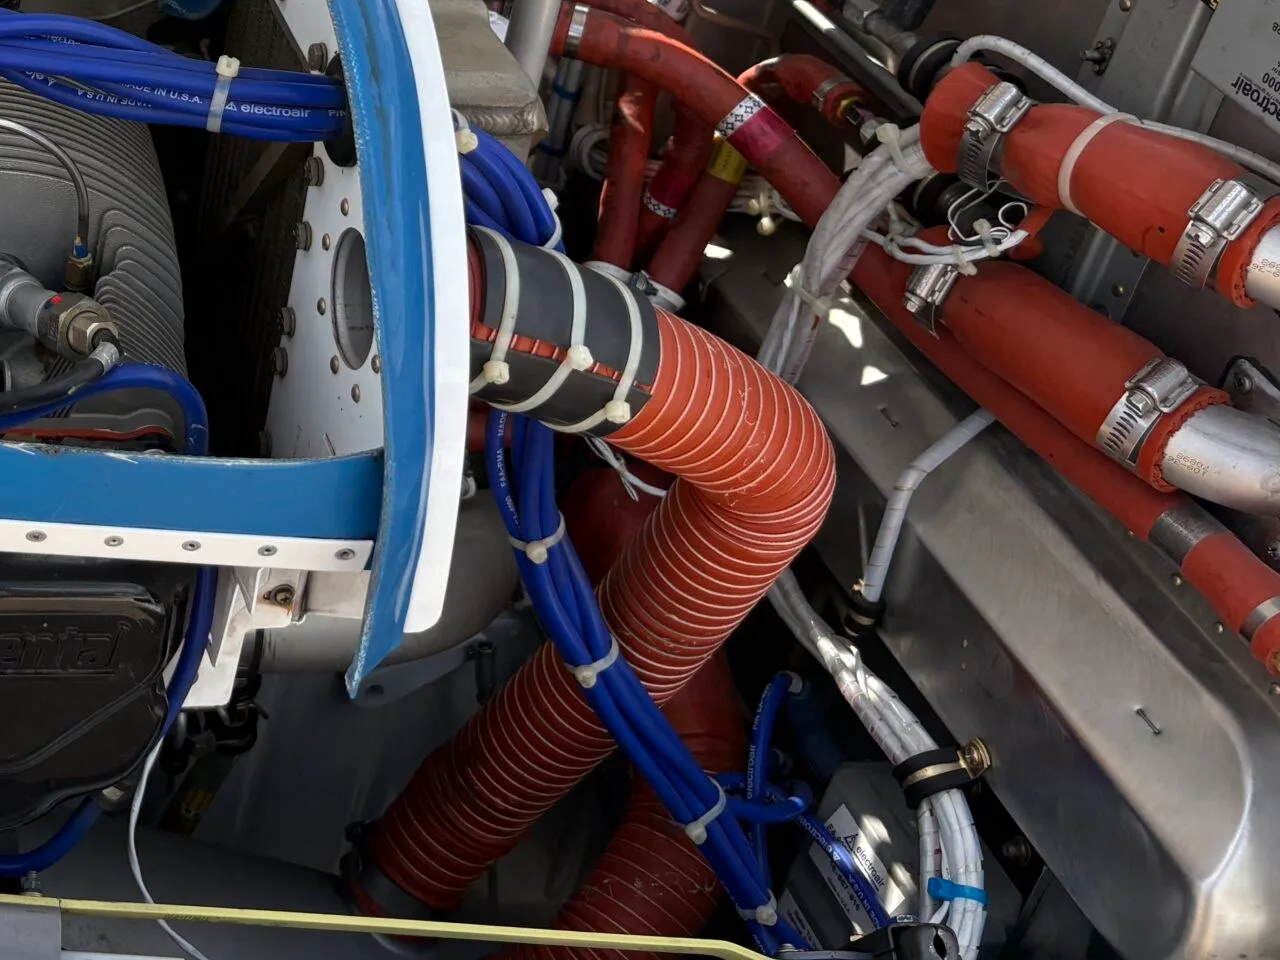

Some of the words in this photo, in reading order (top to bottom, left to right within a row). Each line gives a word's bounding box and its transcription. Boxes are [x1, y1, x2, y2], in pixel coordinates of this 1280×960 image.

[153, 88, 166, 97] IN
[169, 90, 203, 105] U.S.A.
[240, 102, 312, 118] electroair
[855, 845, 886, 888] electroair
